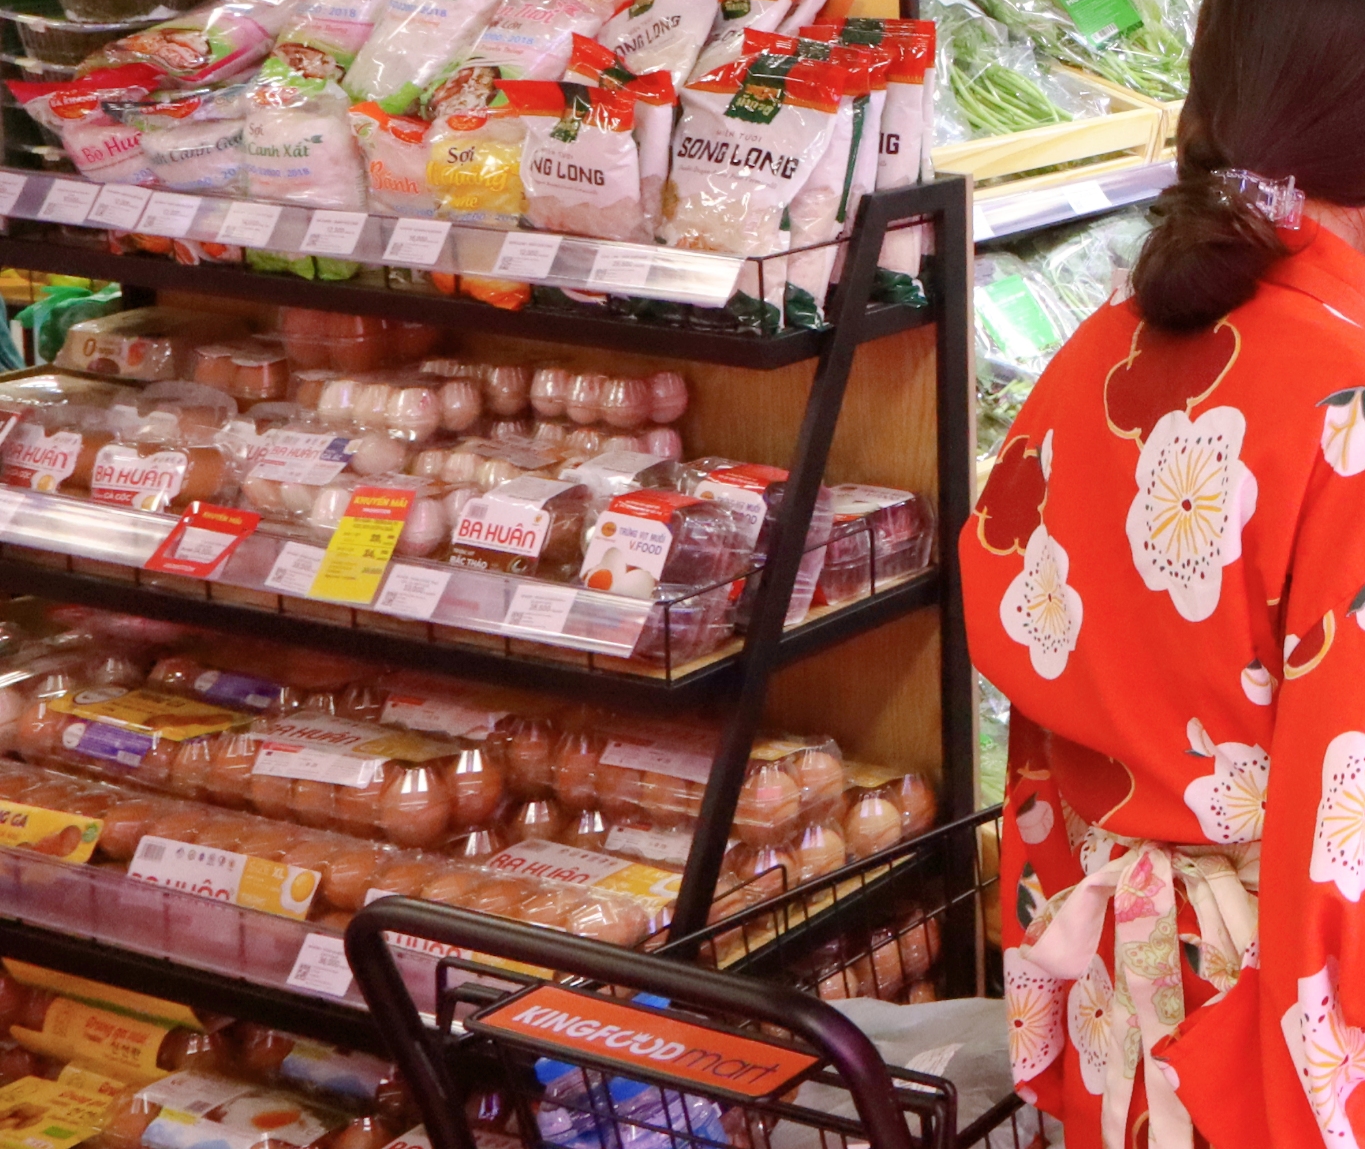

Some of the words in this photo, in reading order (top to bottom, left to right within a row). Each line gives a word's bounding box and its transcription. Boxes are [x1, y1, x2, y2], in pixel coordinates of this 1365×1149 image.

[447, 146, 475, 166] Sợi
[677, 136, 728, 164] SONG
[730, 147, 799, 180] LONG
[556, 162, 605, 186] LONG
[24, 442, 69, 470] HUÂN
[95, 465, 113, 483] BA
[115, 464, 175, 489] HUÂN
[458, 518, 484, 539] BA
[486, 522, 537, 550] HUÂN
[629, 540, 663, 556] V.FOOD
